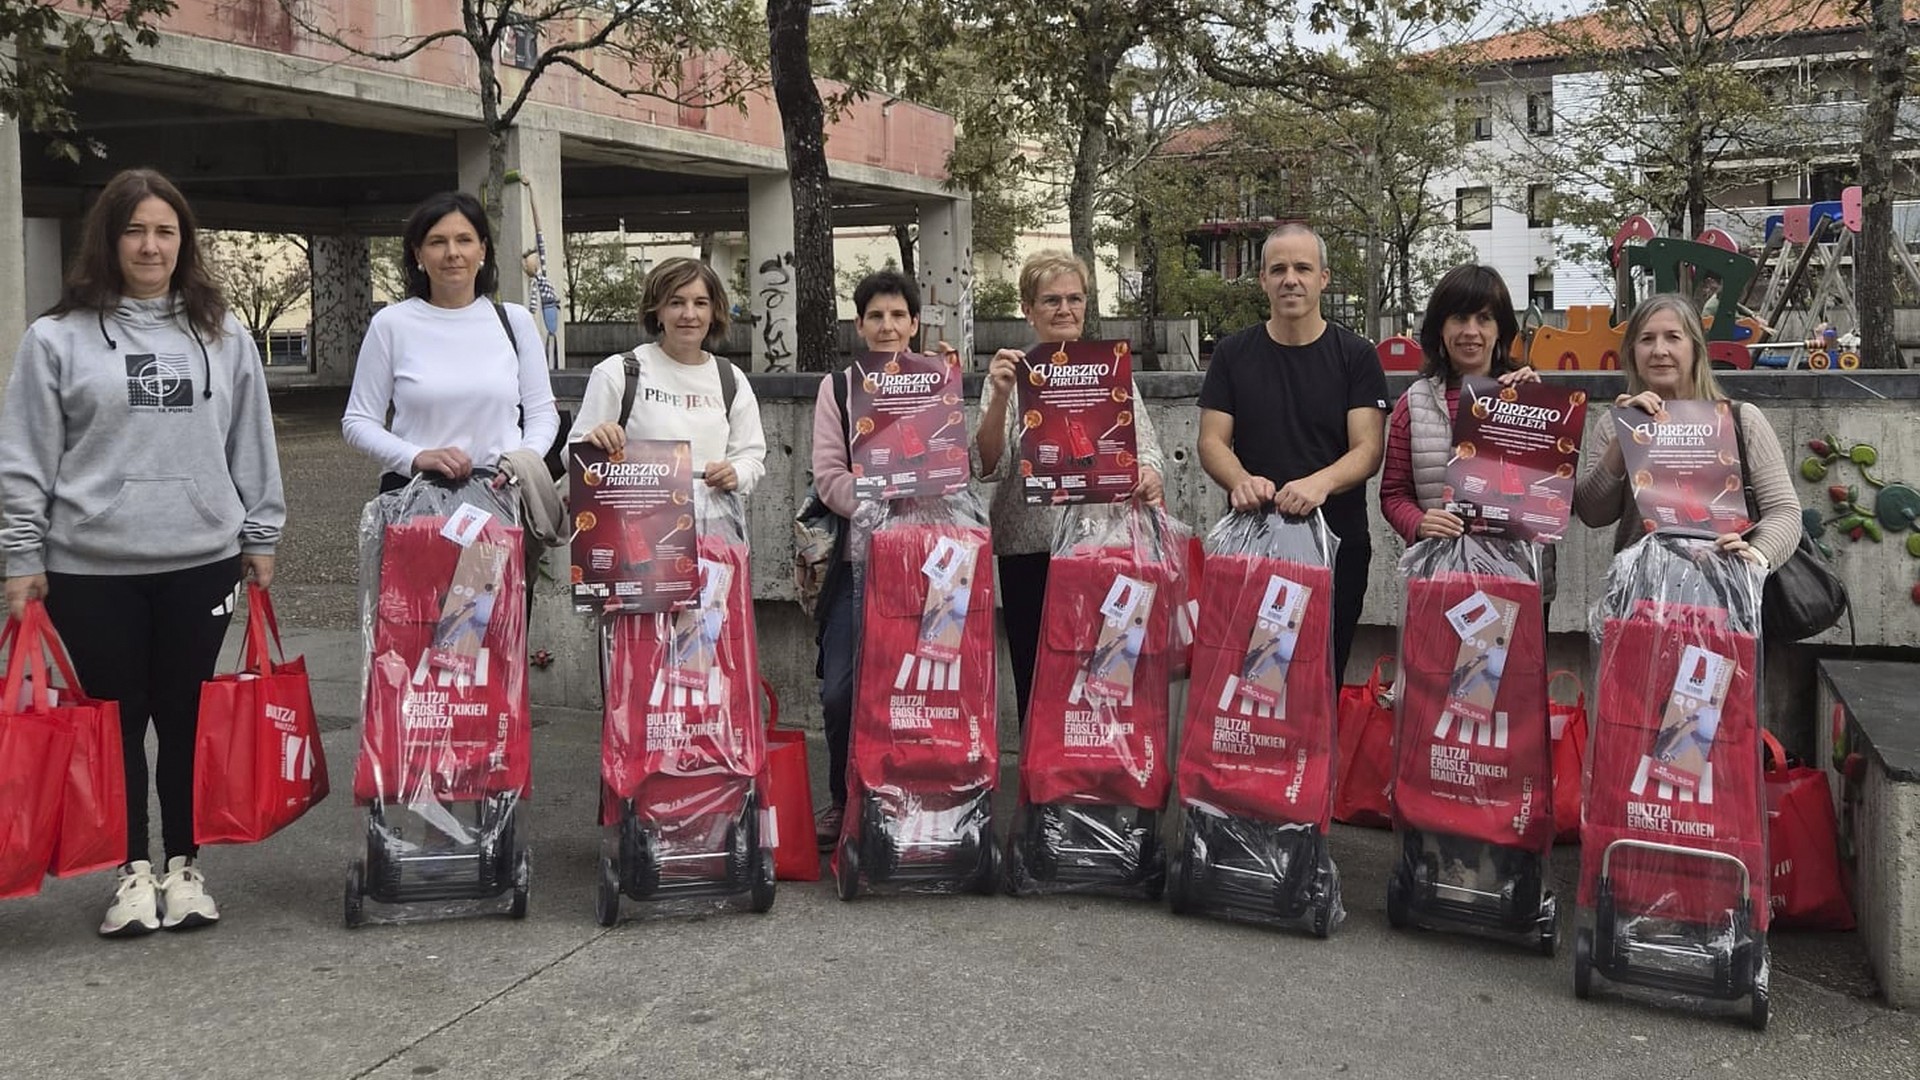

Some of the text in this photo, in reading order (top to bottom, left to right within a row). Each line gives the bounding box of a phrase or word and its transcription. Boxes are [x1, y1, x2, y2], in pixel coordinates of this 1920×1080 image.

[1034, 364, 1110, 378] URREZKO
[867, 372, 940, 387] URREZKO
[1050, 376, 1099, 387] PIRULETA
[882, 384, 931, 395] PIRULETA
[645, 388, 721, 410] PEPE JEAN
[1478, 396, 1561, 423] URREZKO
[1491, 413, 1546, 430] PIRULETA
[1636, 422, 1713, 437] URREZKO
[1656, 436, 1706, 446] PIRULETA
[588, 462, 670, 478] URREZKO
[606, 476, 660, 486] PIRULETA
[407, 704, 488, 716] EROSLE TXIKIEN
[890, 707, 960, 720] EROSLE TXIKIEN
[891, 718, 932, 730] IRAULTZA
[1064, 722, 1097, 735] EROSLE
[970, 716, 981, 757] ROLSER
[1064, 734, 1106, 747] IRAULTZA
[1214, 728, 1286, 749] EROSLE TXIKIEN
[1212, 740, 1256, 756] IRAULTZA
[1292, 748, 1306, 793] ROLSER
[1431, 756, 1508, 778] EROSLE TXIKIEN
[1431, 768, 1476, 786] IRAULTZA
[1520, 777, 1532, 825] ROLSER
[1628, 816, 1714, 838] EROSLE TXIKIEN
